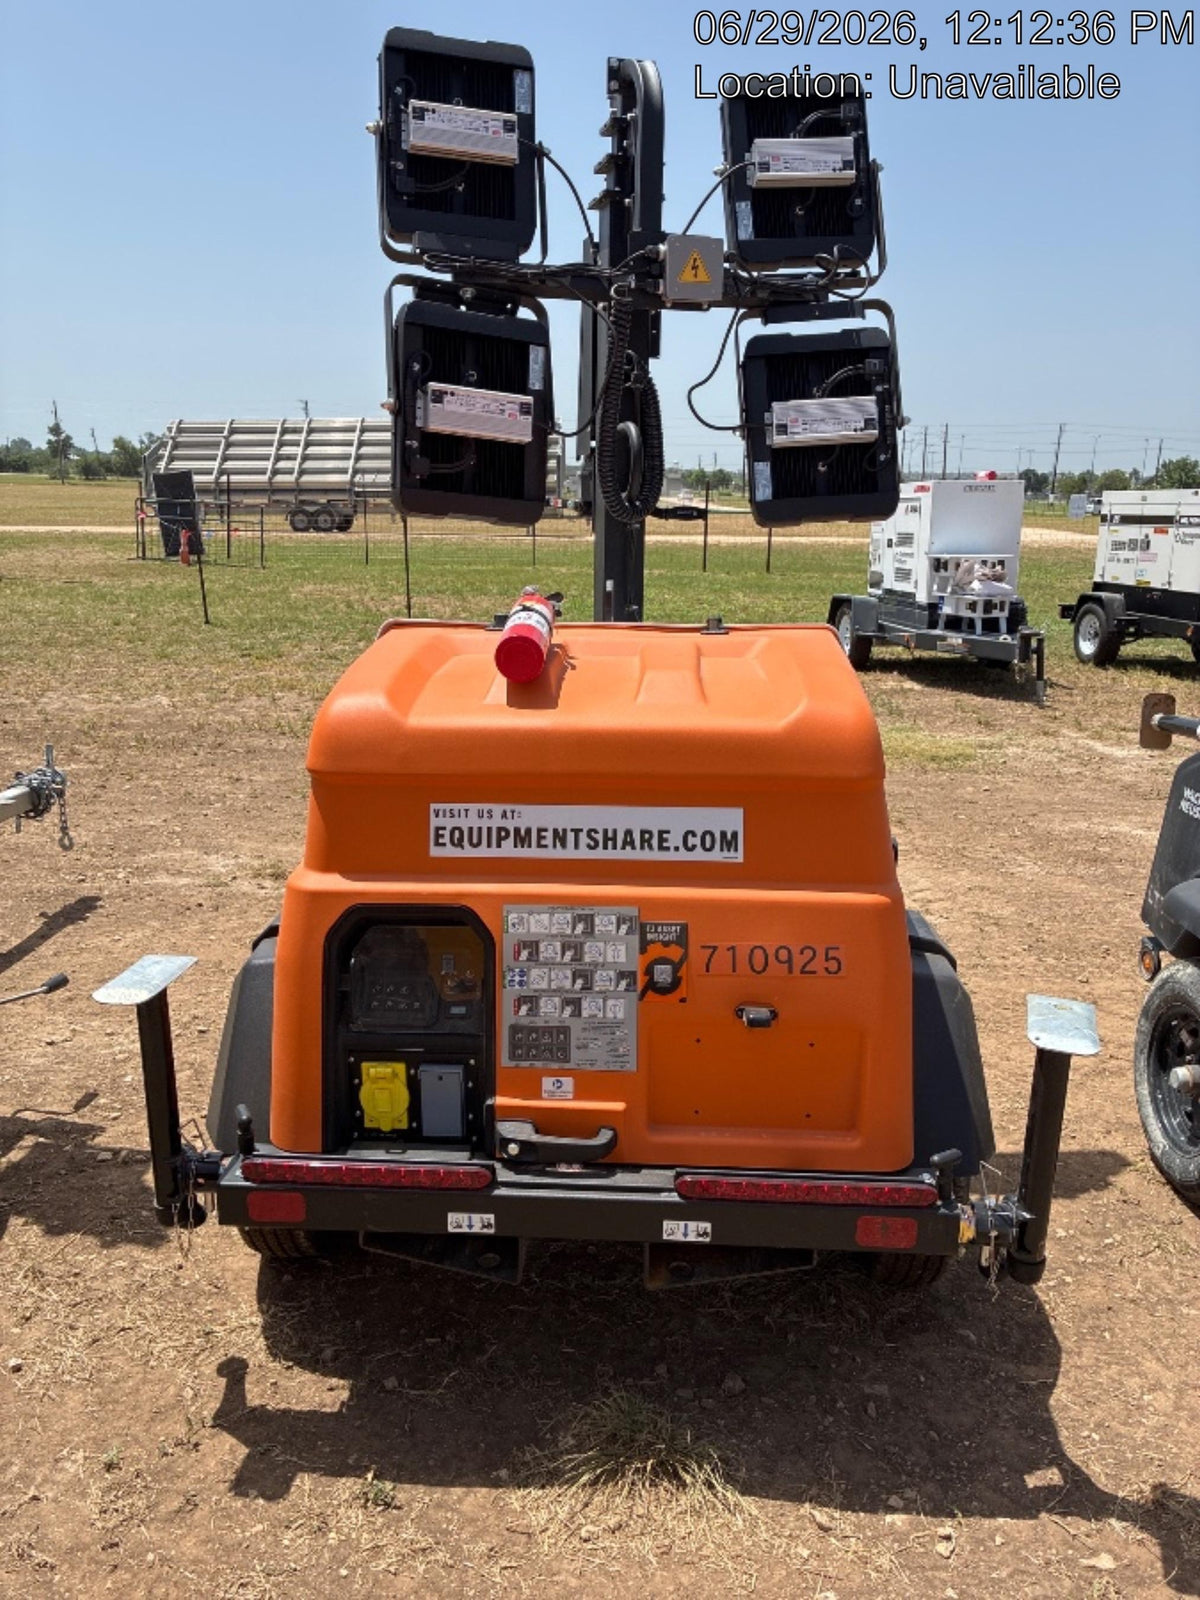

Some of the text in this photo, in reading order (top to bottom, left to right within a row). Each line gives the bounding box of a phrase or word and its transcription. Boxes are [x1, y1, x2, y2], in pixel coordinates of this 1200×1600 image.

[433, 808, 522, 821] VISIT US AT:
[433, 825, 739, 853] EQUIPMENTSHARE.COM
[700, 945, 842, 975] 710925
